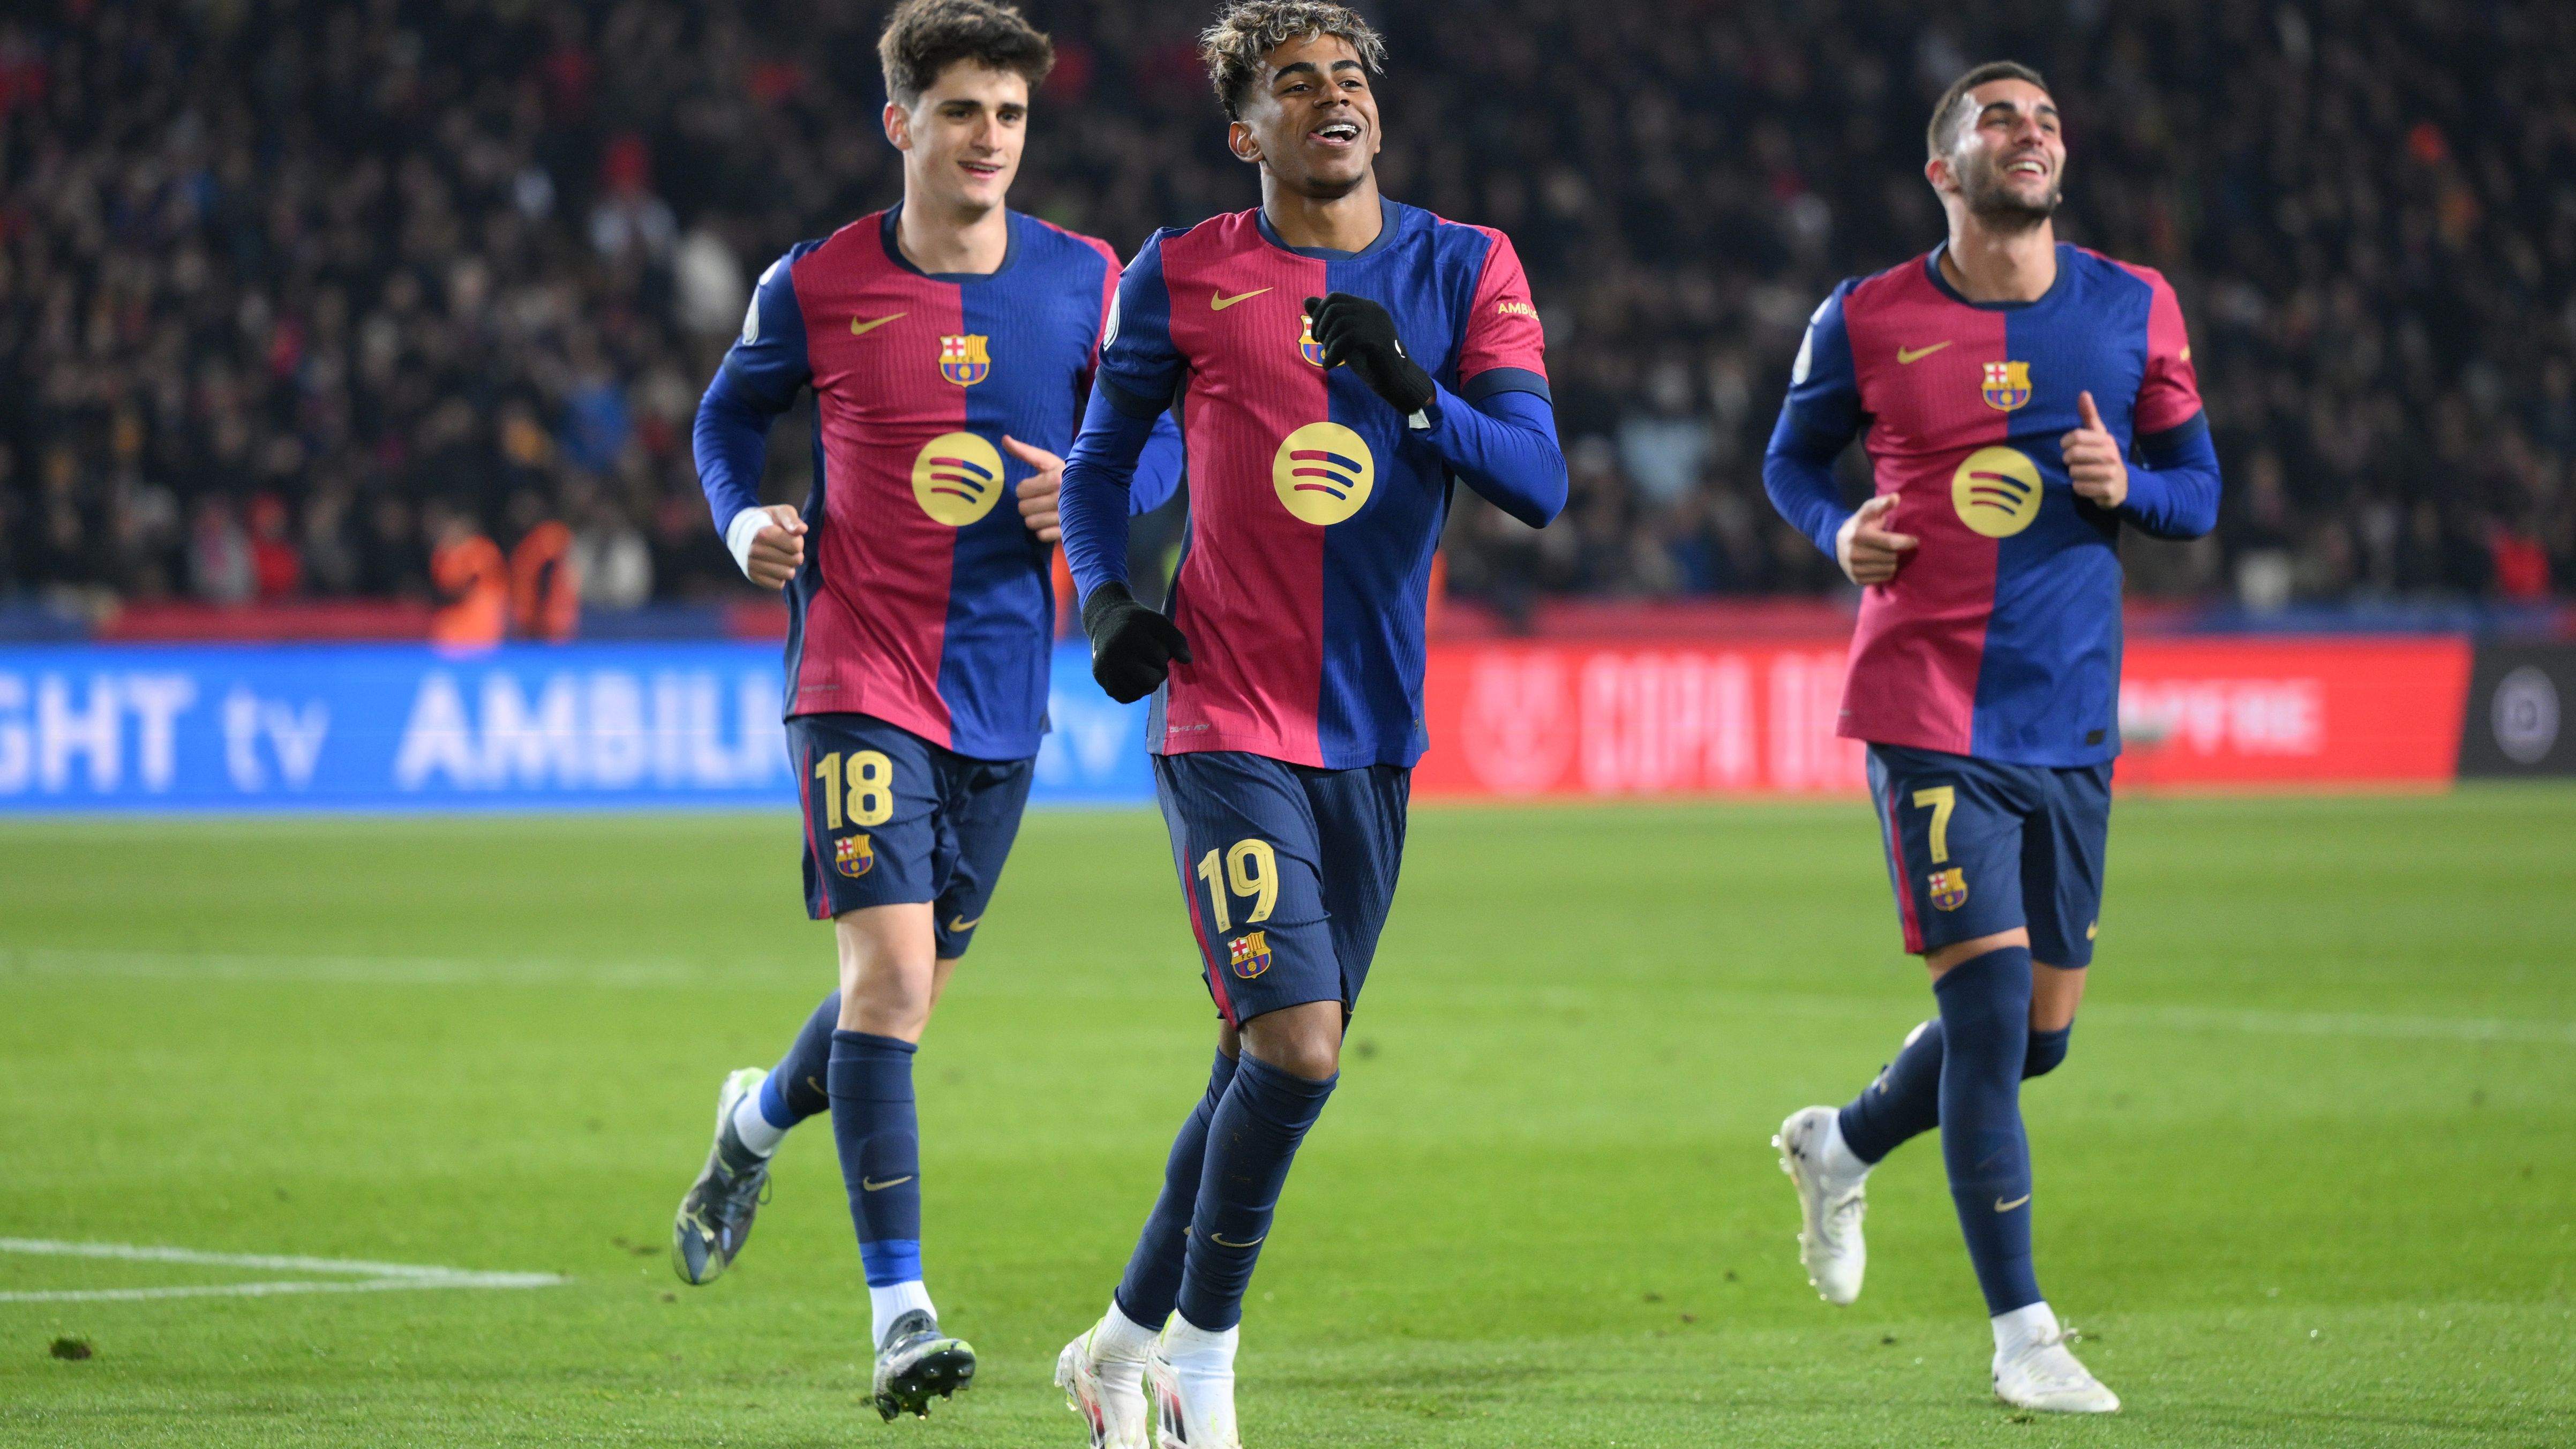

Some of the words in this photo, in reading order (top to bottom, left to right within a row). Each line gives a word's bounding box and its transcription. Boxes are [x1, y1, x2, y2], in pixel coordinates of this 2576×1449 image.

[222, 685, 330, 793] tv
[1581, 651, 1756, 792] COPA
[815, 750, 893, 830] 18
[1912, 785, 1955, 864] 7
[1197, 838, 1279, 934] 19
[1242, 951, 1257, 960] FCB
